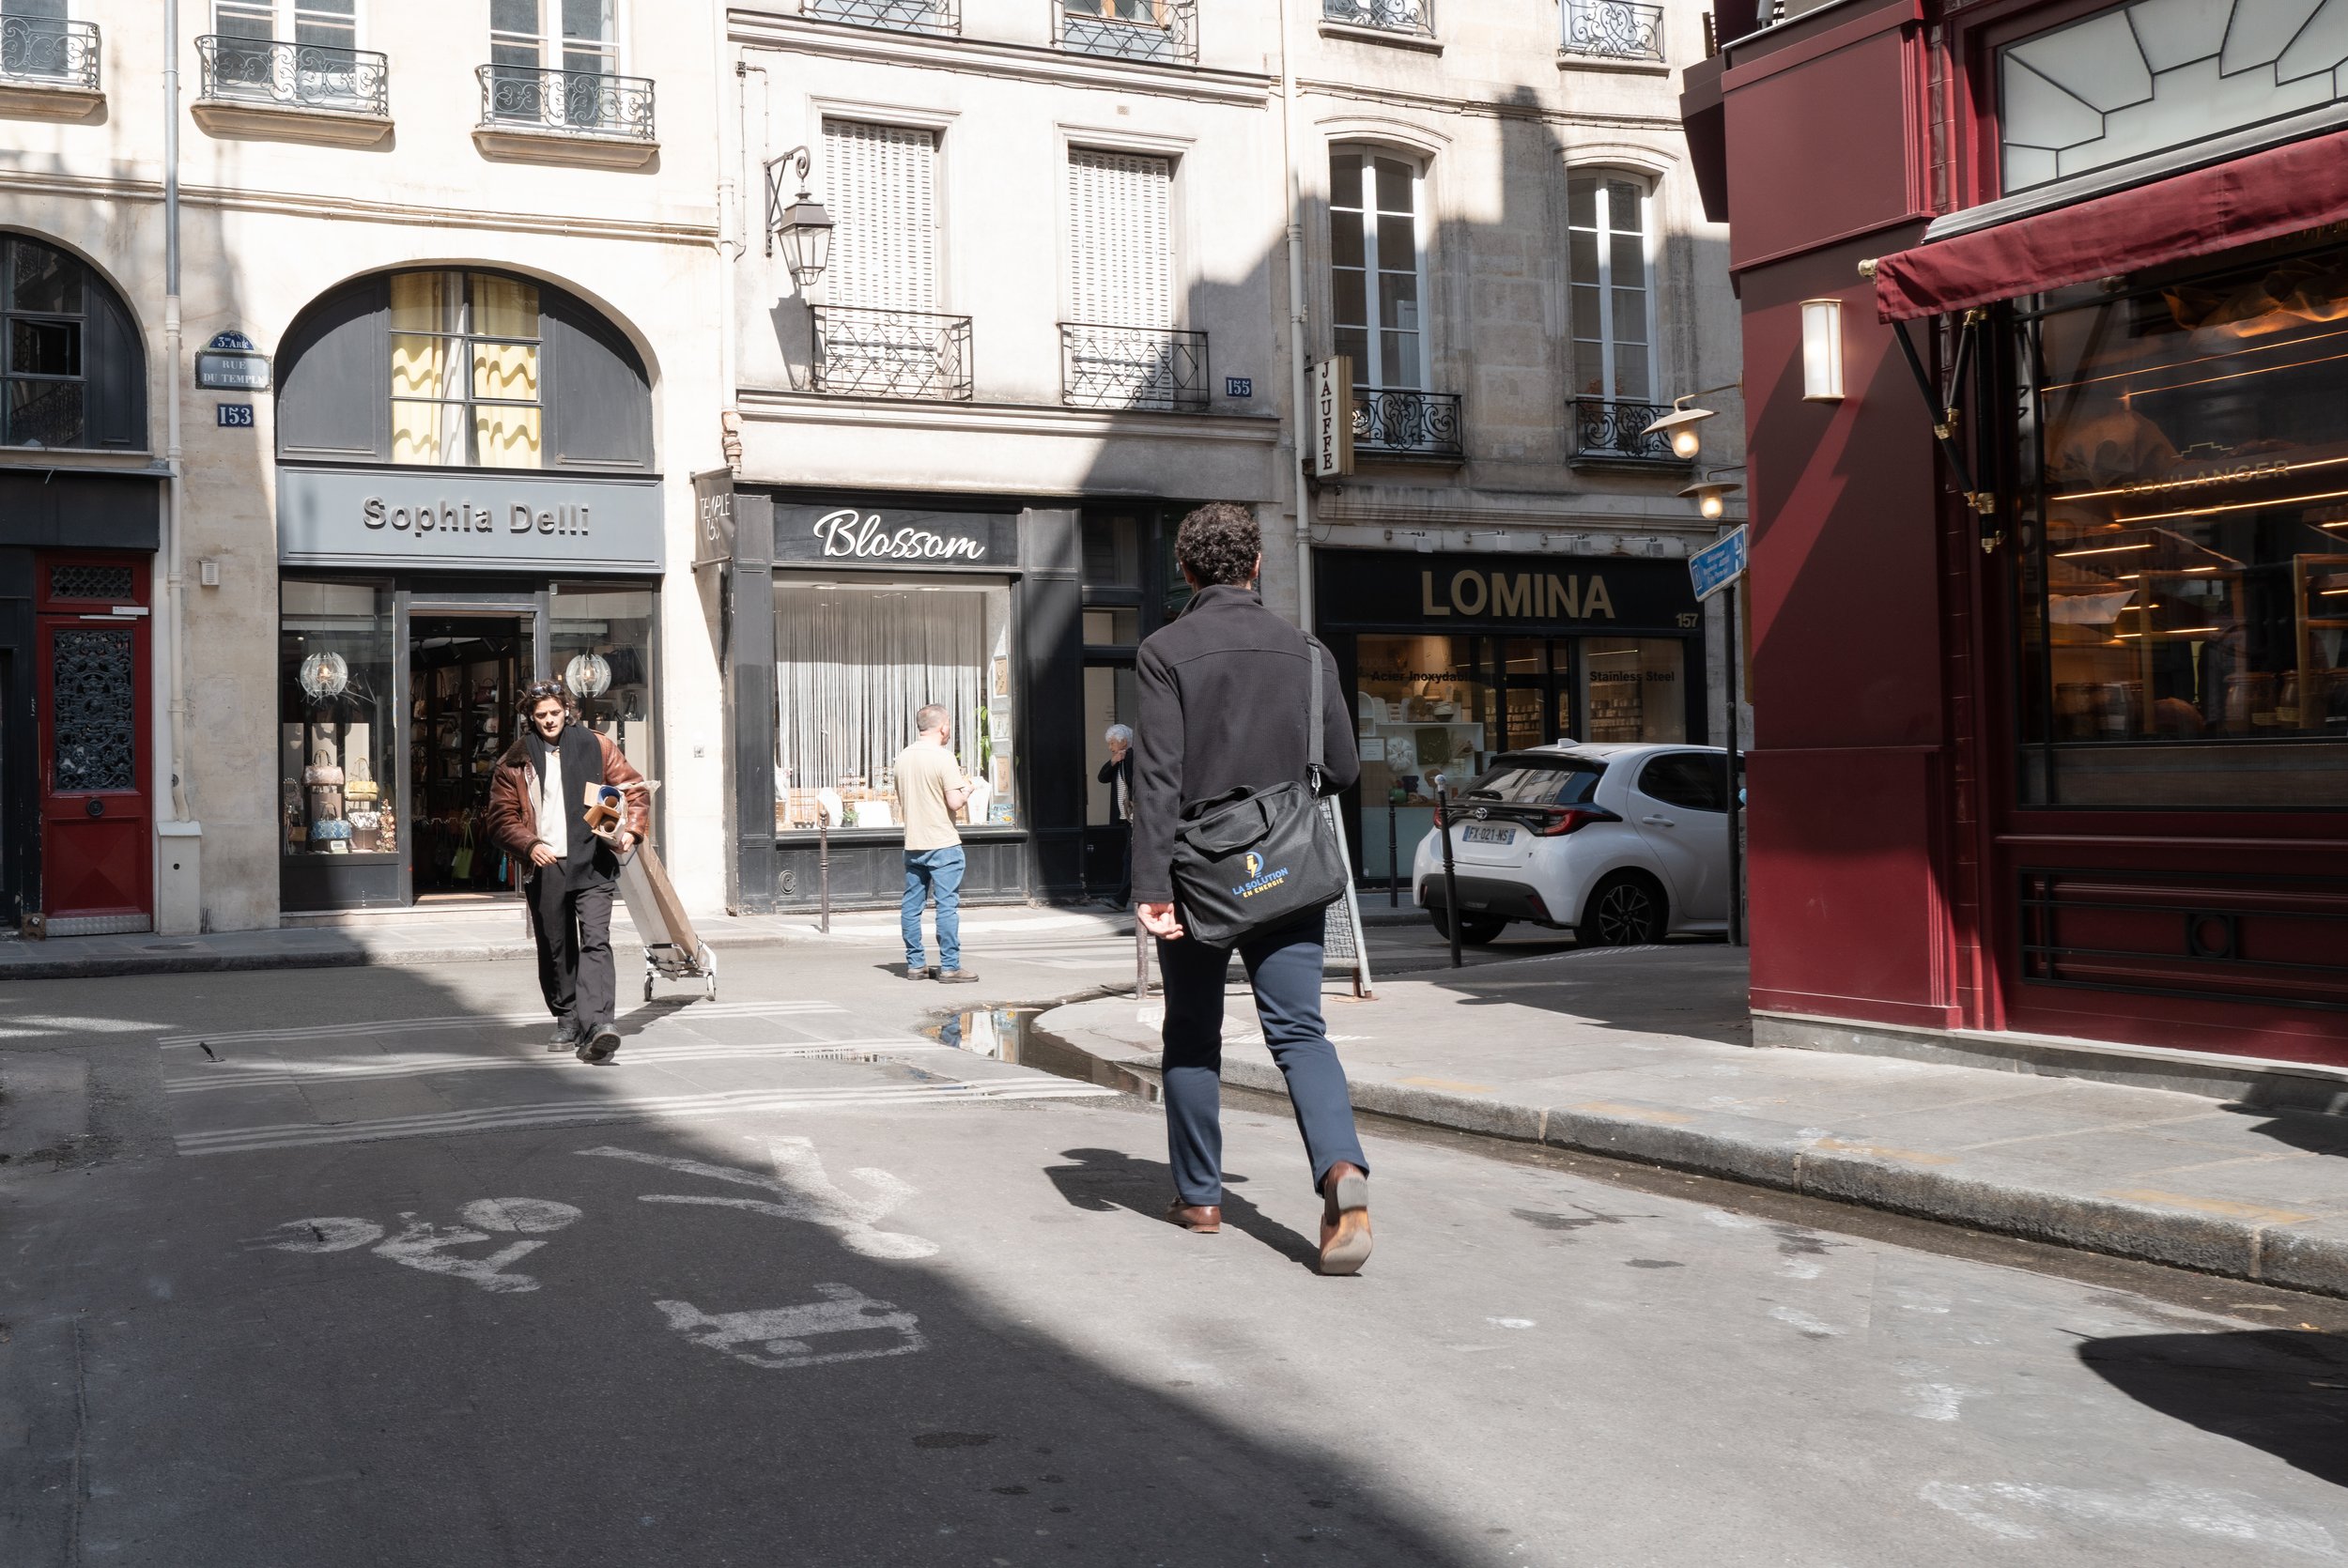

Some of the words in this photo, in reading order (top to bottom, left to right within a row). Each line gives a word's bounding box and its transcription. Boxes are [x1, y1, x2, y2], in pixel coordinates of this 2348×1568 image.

[222, 360, 247, 370] RUE
[203, 373, 217, 383] DU
[1228, 379, 1250, 395] 155
[220, 407, 252, 424] 153
[1321, 361, 1333, 470] JAUFFE
[2122, 459, 2291, 499] BOULANGER
[363, 495, 493, 538] Sophia
[509, 500, 589, 536] Delli
[813, 509, 985, 560] Blossom
[1421, 569, 1616, 619] LOMINA
[1676, 613, 1698, 628] 157
[1371, 670, 1405, 682] Acier
[1409, 670, 1475, 684] Inoxydabl
[1589, 670, 1642, 682] Stainless
[1645, 670, 1675, 682] Steel
[1232, 885, 1245, 895] LA
[1245, 868, 1289, 890] SOLUTION
[1243, 890, 1253, 899] EN
[1254, 878, 1285, 894] ENERGIE
